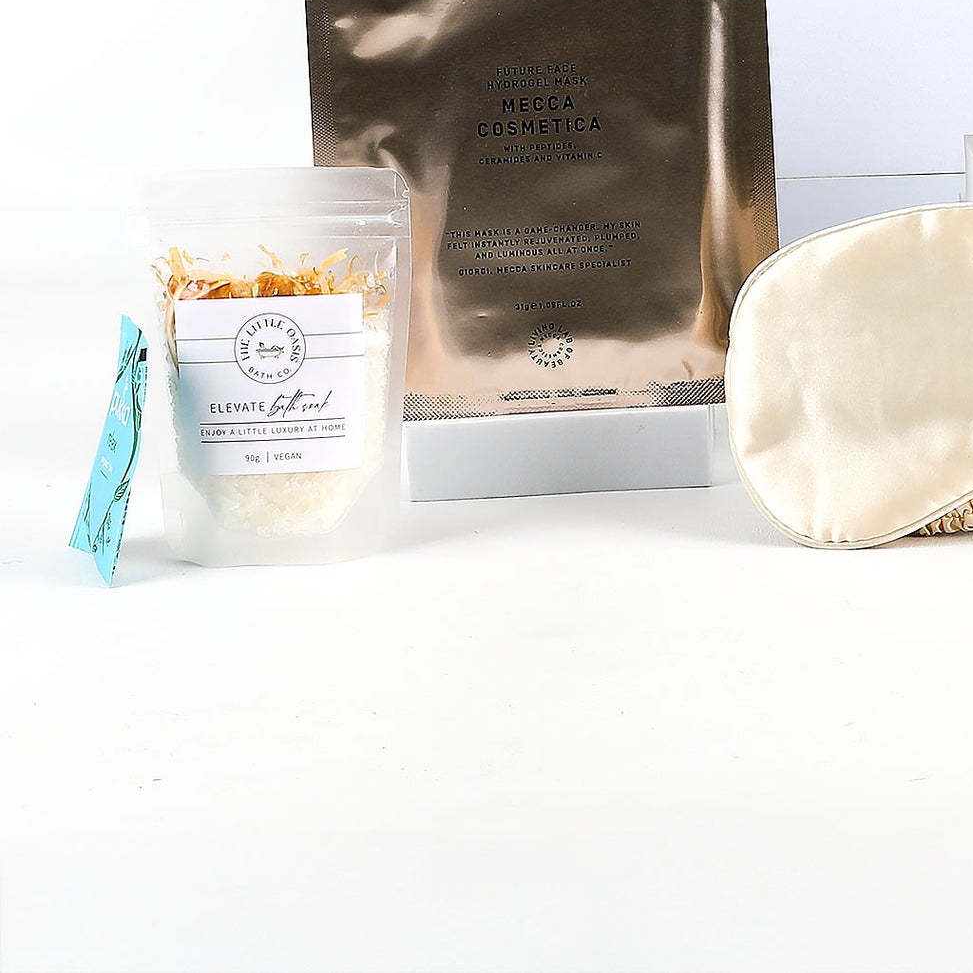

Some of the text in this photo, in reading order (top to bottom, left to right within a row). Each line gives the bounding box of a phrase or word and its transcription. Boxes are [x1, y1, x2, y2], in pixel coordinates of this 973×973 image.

[496, 63, 577, 77] FUTURE FACE
[487, 75, 588, 90] HYDROGEL MASK
[502, 94, 575, 114] MECCA
[477, 116, 601, 138] COSMETICA
[503, 144, 526, 153] WITH
[479, 150, 603, 165] CERAMIDES AND VITAMIN C
[474, 228, 500, 238] MASK
[502, 228, 512, 236] IS
[514, 227, 521, 236] A
[603, 222, 616, 230] MY
[619, 220, 641, 229] SKIN
[447, 241, 468, 250] FELT
[471, 238, 521, 249] INSTANTLY
[475, 250, 494, 260] AND
[497, 248, 544, 258] LUMINOUS
[546, 247, 563, 256] ALL
[566, 246, 578, 255] AT
[496, 265, 528, 274] MECCA
[530, 262, 576, 272] SKINCARE
[579, 259, 632, 270] SPECIALIST
[240, 318, 301, 363] THE LITTLE OASIS
[528, 322, 574, 368] LIVING LAB OF BEAUTY
[248, 366, 273, 380] BATH
[209, 388, 333, 418] ELEVATE bath soak
[200, 423, 346, 437] ENJOY A LITTLE LUXURY AT HOME
[244, 452, 302, 464] 90g VEGAN
